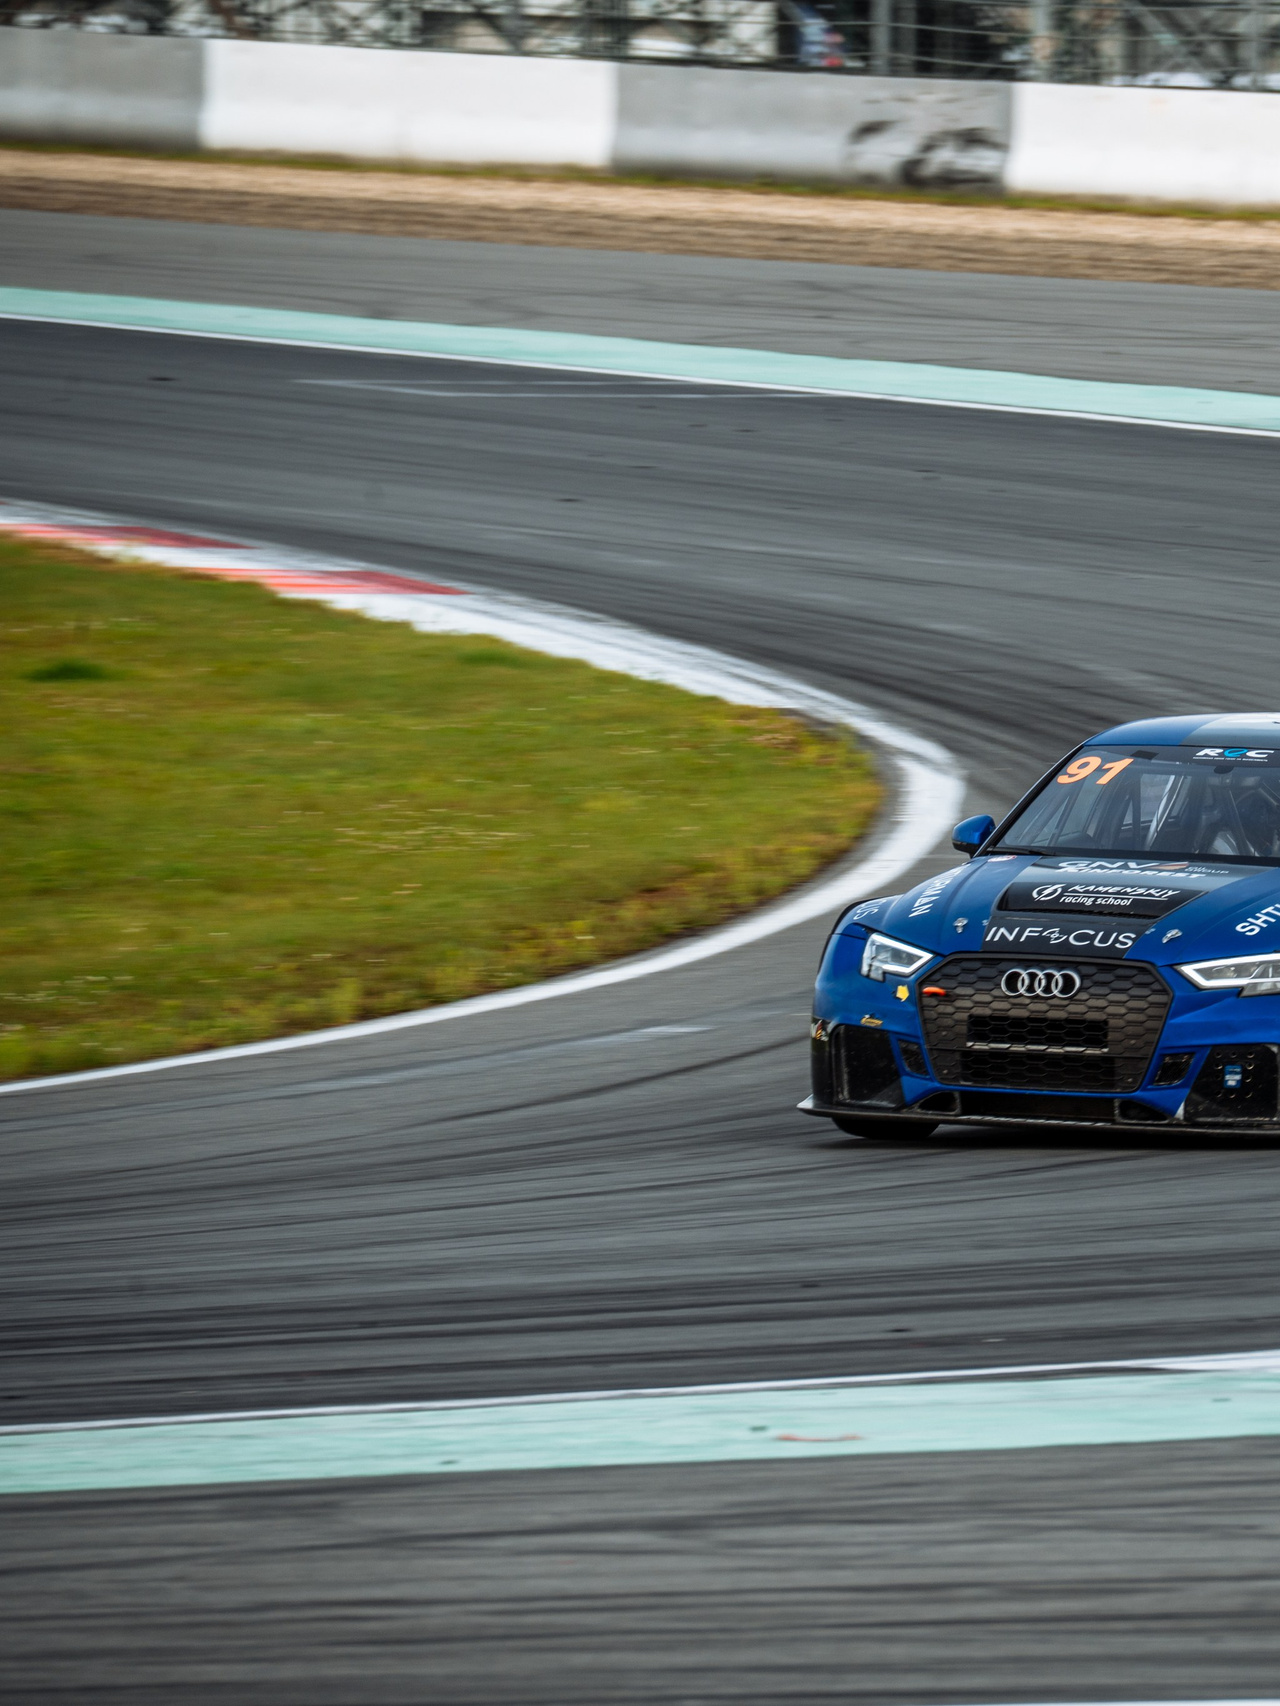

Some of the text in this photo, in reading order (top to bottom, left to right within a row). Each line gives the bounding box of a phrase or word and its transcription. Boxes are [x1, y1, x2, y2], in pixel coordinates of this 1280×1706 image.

[1057, 756, 1134, 785] 91
[1068, 884, 1181, 898] KAMENSKIY
[1059, 896, 1133, 906] racing school
